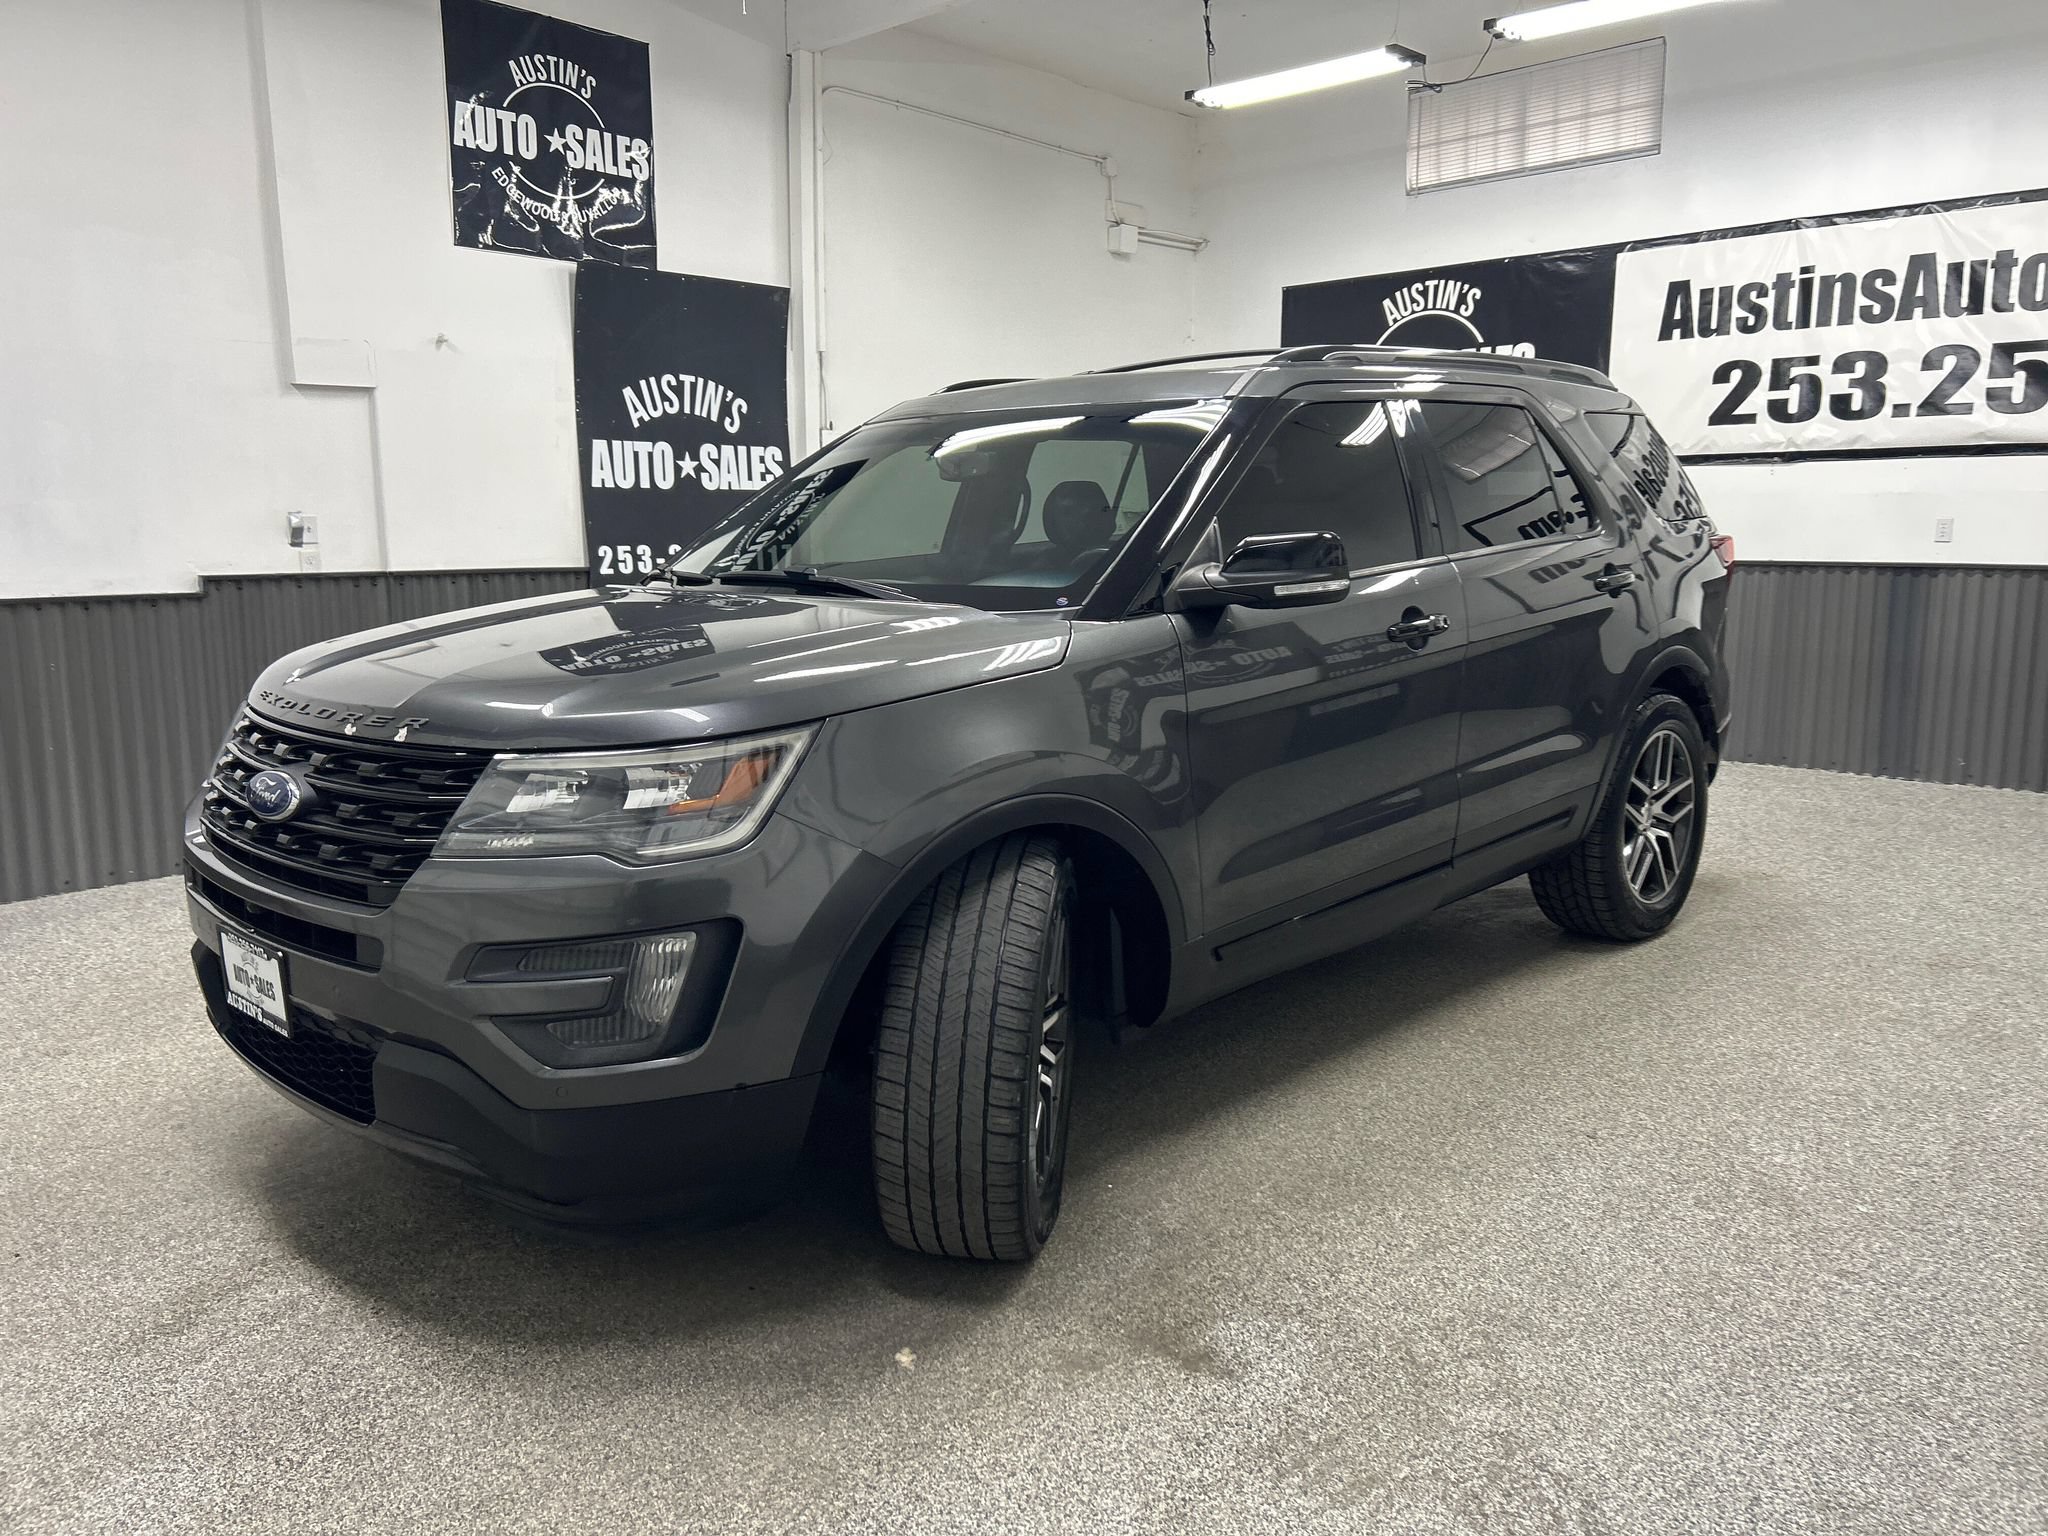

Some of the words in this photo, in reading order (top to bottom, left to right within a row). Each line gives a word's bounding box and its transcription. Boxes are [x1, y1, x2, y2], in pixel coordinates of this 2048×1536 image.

[508, 54, 597, 99] AUSTIN'S
[453, 100, 538, 160] AUTO
[565, 123, 651, 182] SALES
[491, 166, 560, 223] EDGEWOOD
[1381, 280, 1482, 326] AUSTIN'S
[622, 373, 748, 434] AUSTIN'S
[591, 438, 675, 490] AUTO
[699, 443, 783, 490] SALES
[260, 690, 430, 730] EXPLORER
[233, 963, 251, 989] AUTO
[254, 974, 277, 1002] SALES
[226, 991, 264, 1022] AUSTIN'S
